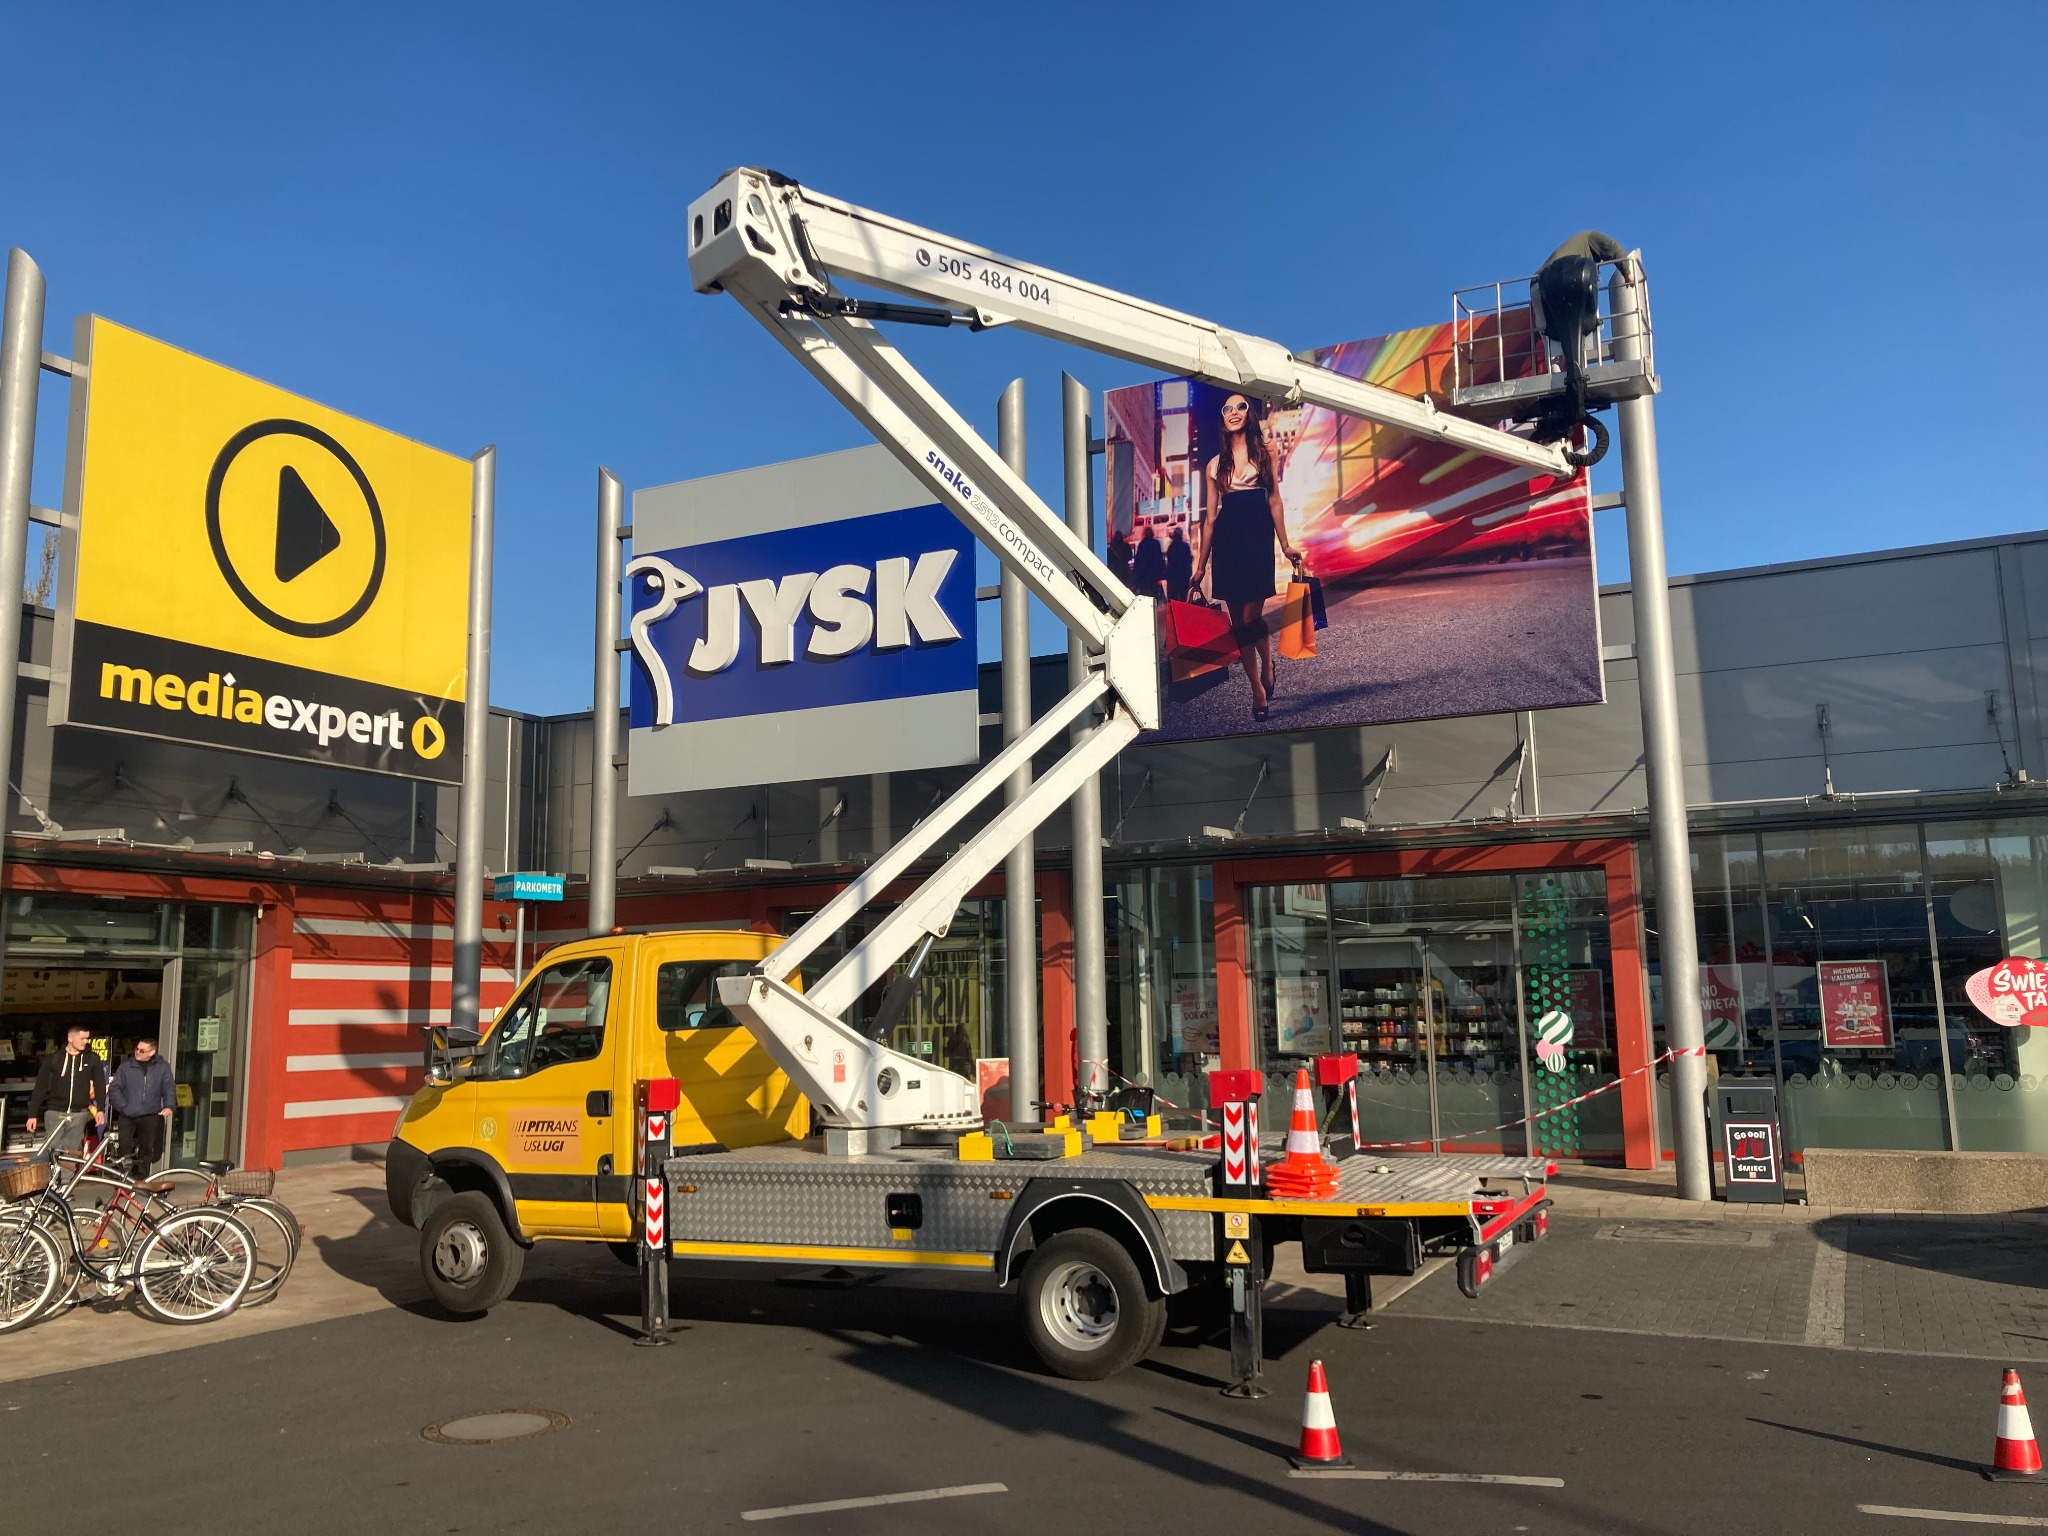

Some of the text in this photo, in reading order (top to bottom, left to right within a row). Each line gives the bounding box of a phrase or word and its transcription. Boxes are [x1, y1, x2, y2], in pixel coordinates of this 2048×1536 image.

[938, 254, 1051, 305] 505 484 004
[926, 450, 1055, 582] snake 2512 compact
[688, 548, 963, 673] JYSK
[99, 662, 404, 751] mediaexpert
[515, 880, 562, 894] PARKOMETR
[527, 1119, 579, 1133] PITRANS
[523, 1140, 565, 1152] USŁUGI
[1737, 1163, 1767, 1172] ŚMIECI
